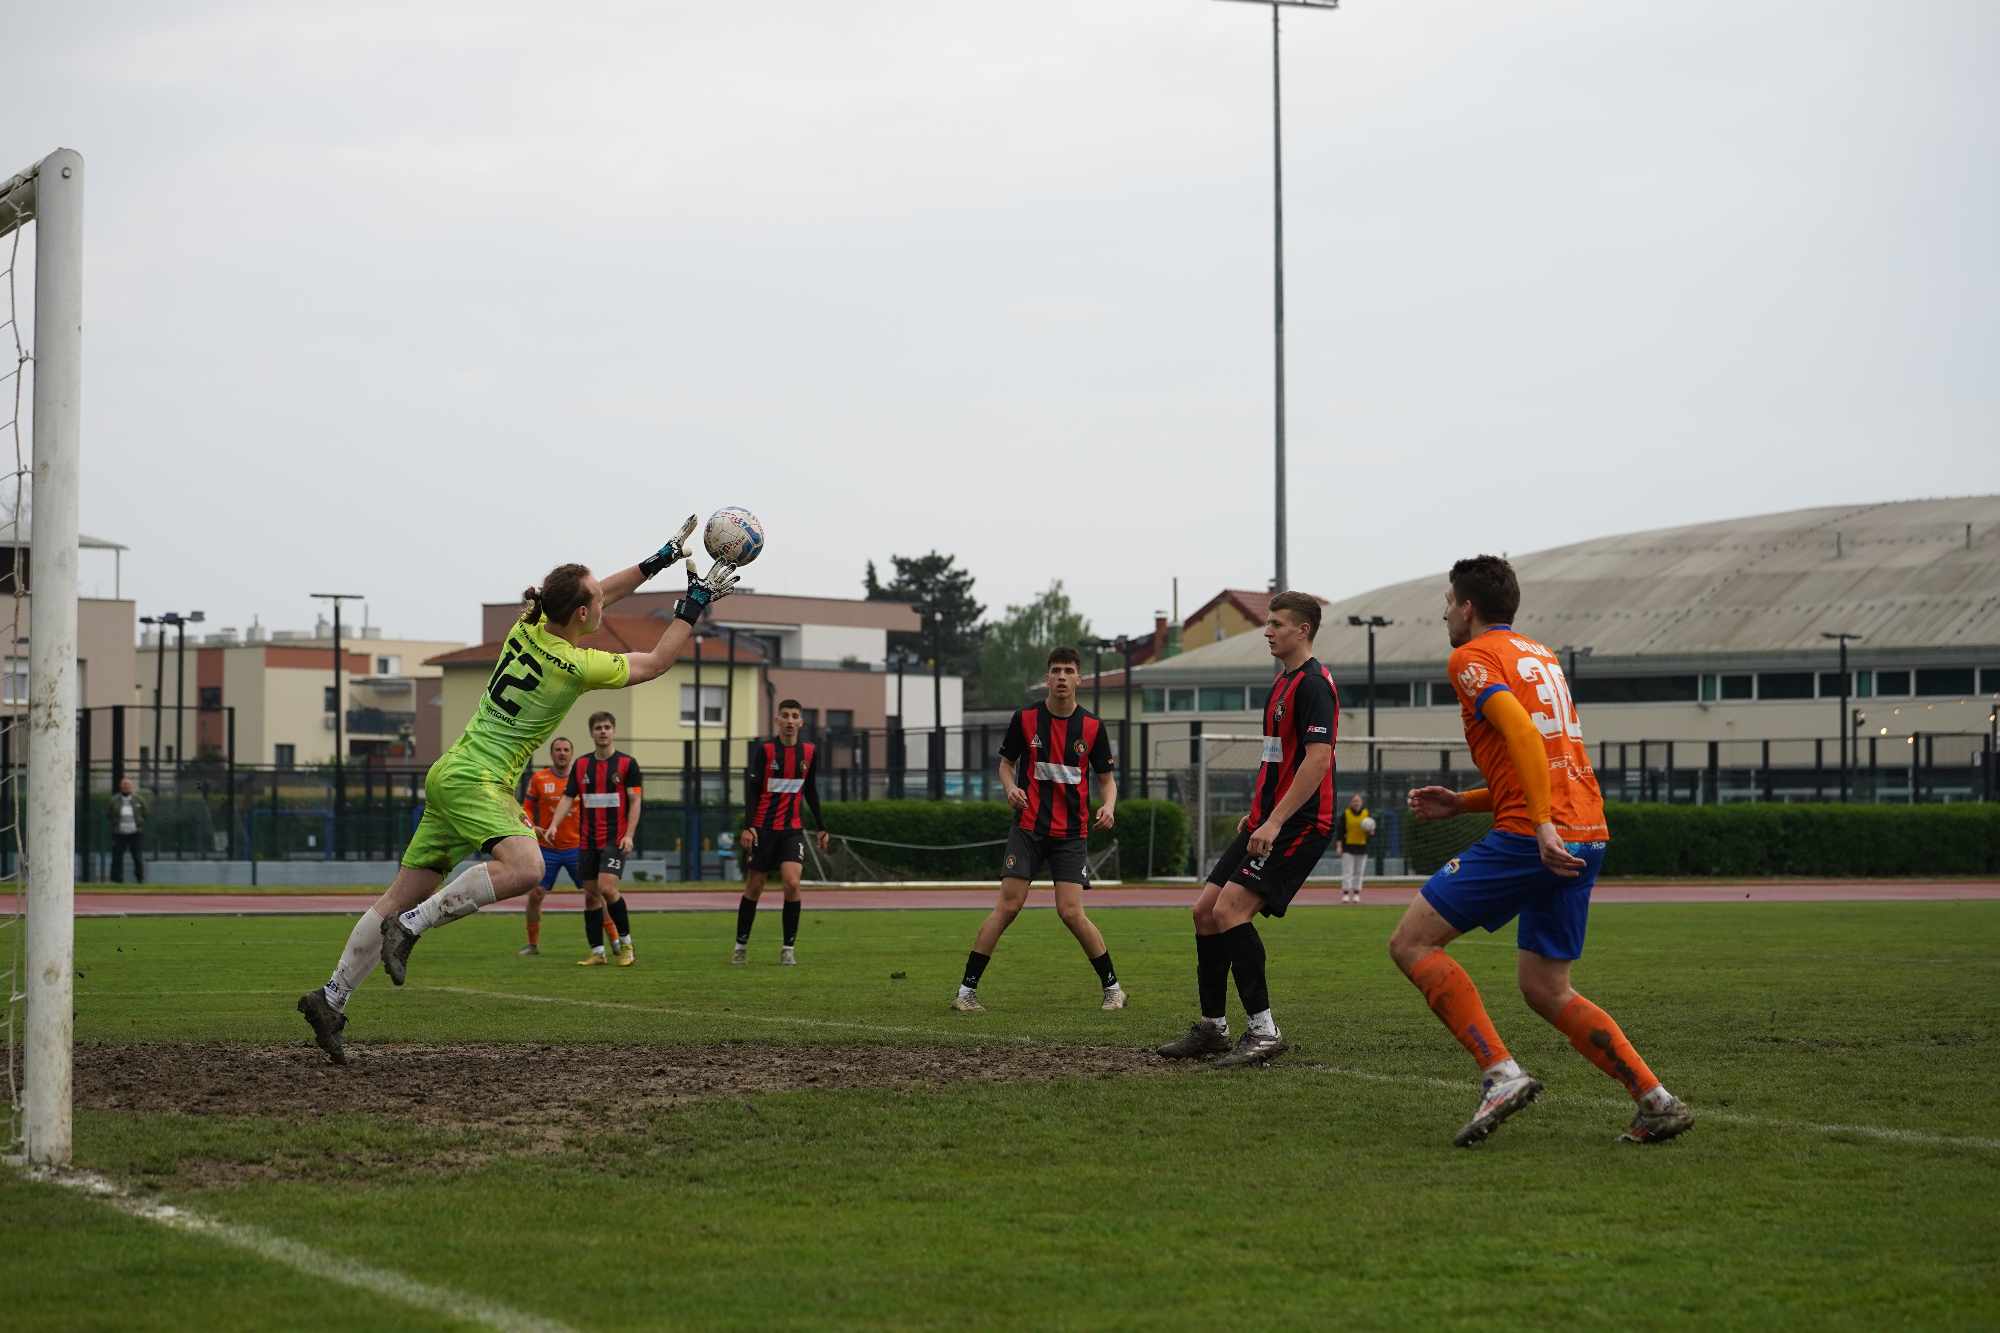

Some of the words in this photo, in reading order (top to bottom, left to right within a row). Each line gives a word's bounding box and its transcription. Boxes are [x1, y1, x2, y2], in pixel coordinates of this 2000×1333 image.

[487, 637, 543, 718] 12
[1516, 656, 1584, 743] 30
[607, 857, 621, 870] 23
[1080, 862, 1088, 879] 4
